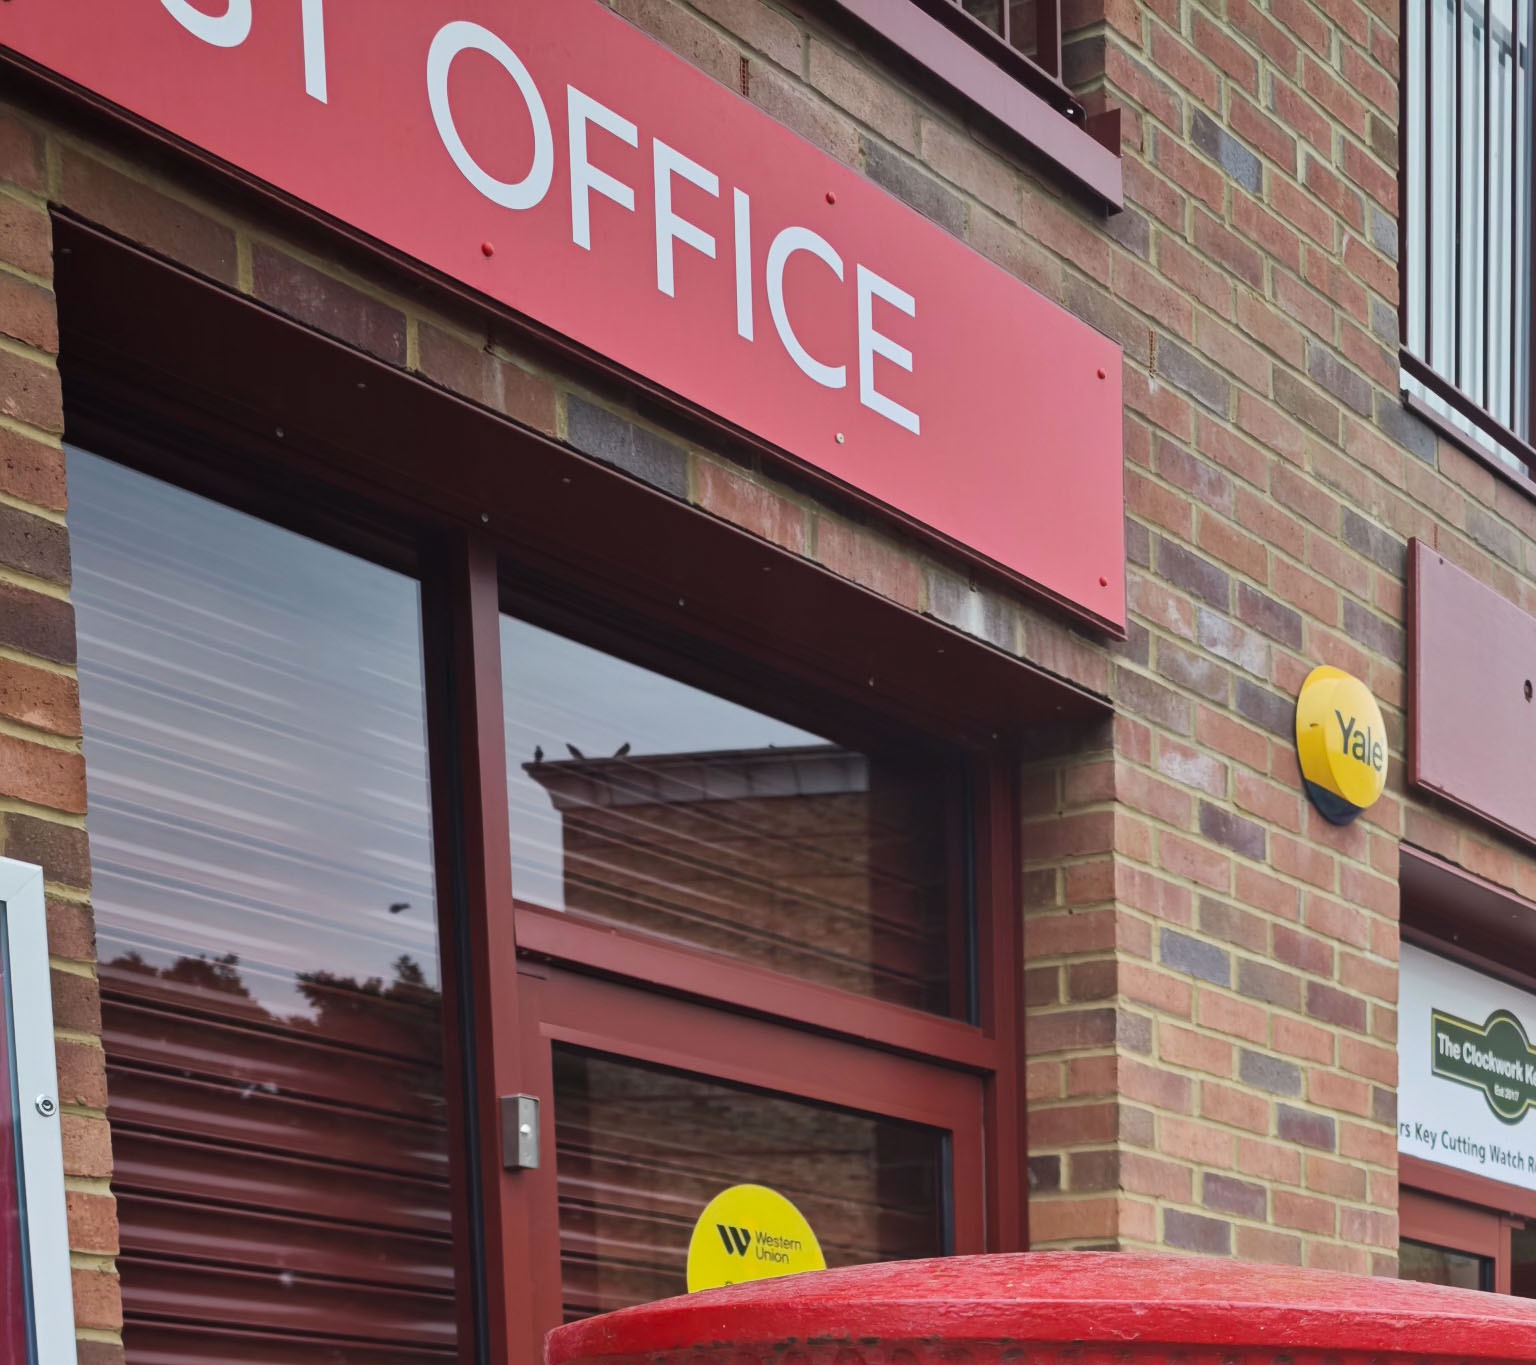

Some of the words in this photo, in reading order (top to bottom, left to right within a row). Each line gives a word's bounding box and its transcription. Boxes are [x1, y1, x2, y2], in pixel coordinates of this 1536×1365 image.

[427, 20, 920, 435] OFFICE
[1335, 709, 1383, 772] Yale
[1437, 1033, 1461, 1060] The
[1463, 1042, 1524, 1082] Clockwork
[1415, 1123, 1437, 1150] Key
[1441, 1130, 1485, 1164] Cutting
[1490, 1144, 1524, 1171] Watch
[755, 1231, 802, 1253] Western
[755, 1247, 789, 1264] Union
